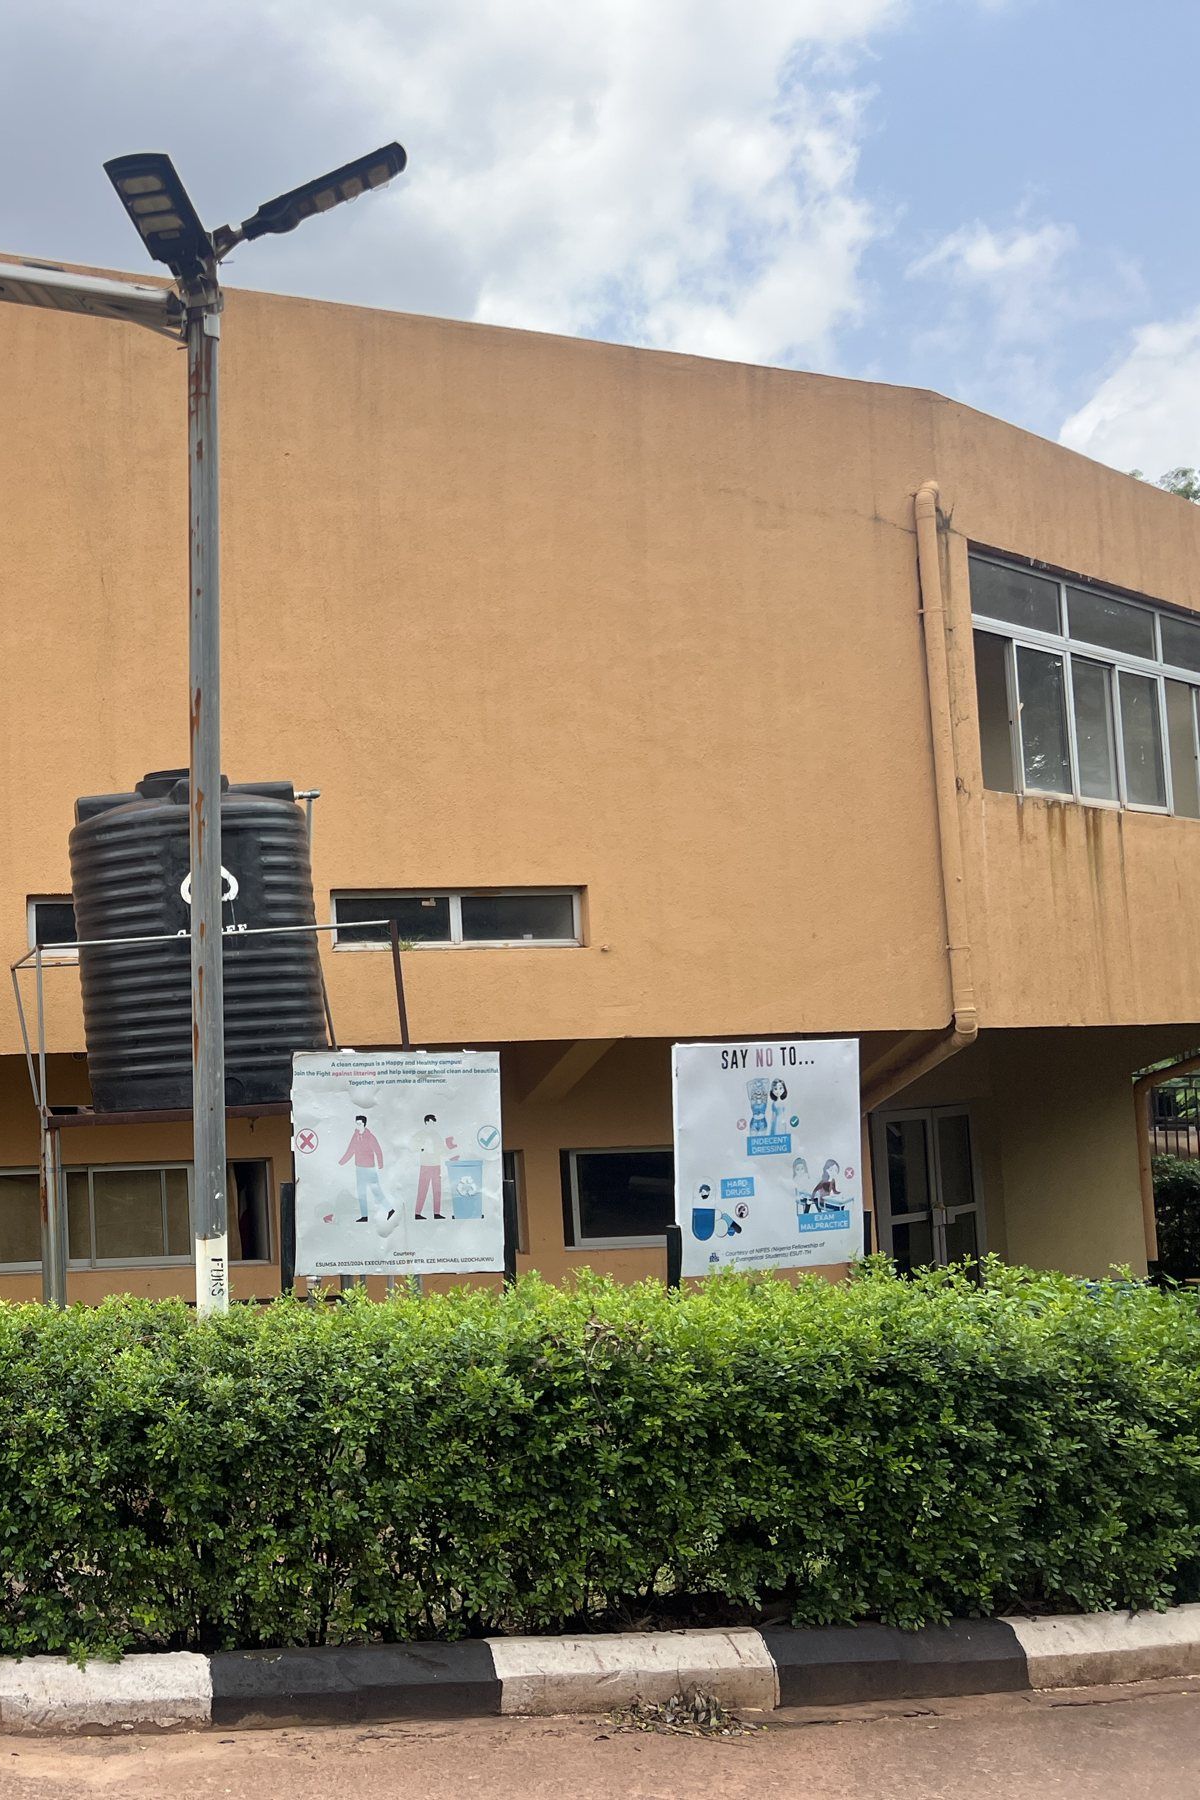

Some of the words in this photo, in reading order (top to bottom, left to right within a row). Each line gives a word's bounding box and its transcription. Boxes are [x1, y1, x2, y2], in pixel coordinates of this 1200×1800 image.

[721, 1048, 748, 1069] SAY
[756, 1047, 773, 1068] NO
[779, 1046, 815, 1067] TO...
[751, 1136, 787, 1146] INDECENT
[751, 1144, 787, 1154] DRESSING
[725, 1188, 751, 1196] DRUGS
[800, 1220, 849, 1230] MALPRACTICE
[725, 1249, 748, 1257] Courtesy
[792, 1243, 818, 1252] Fellowship
